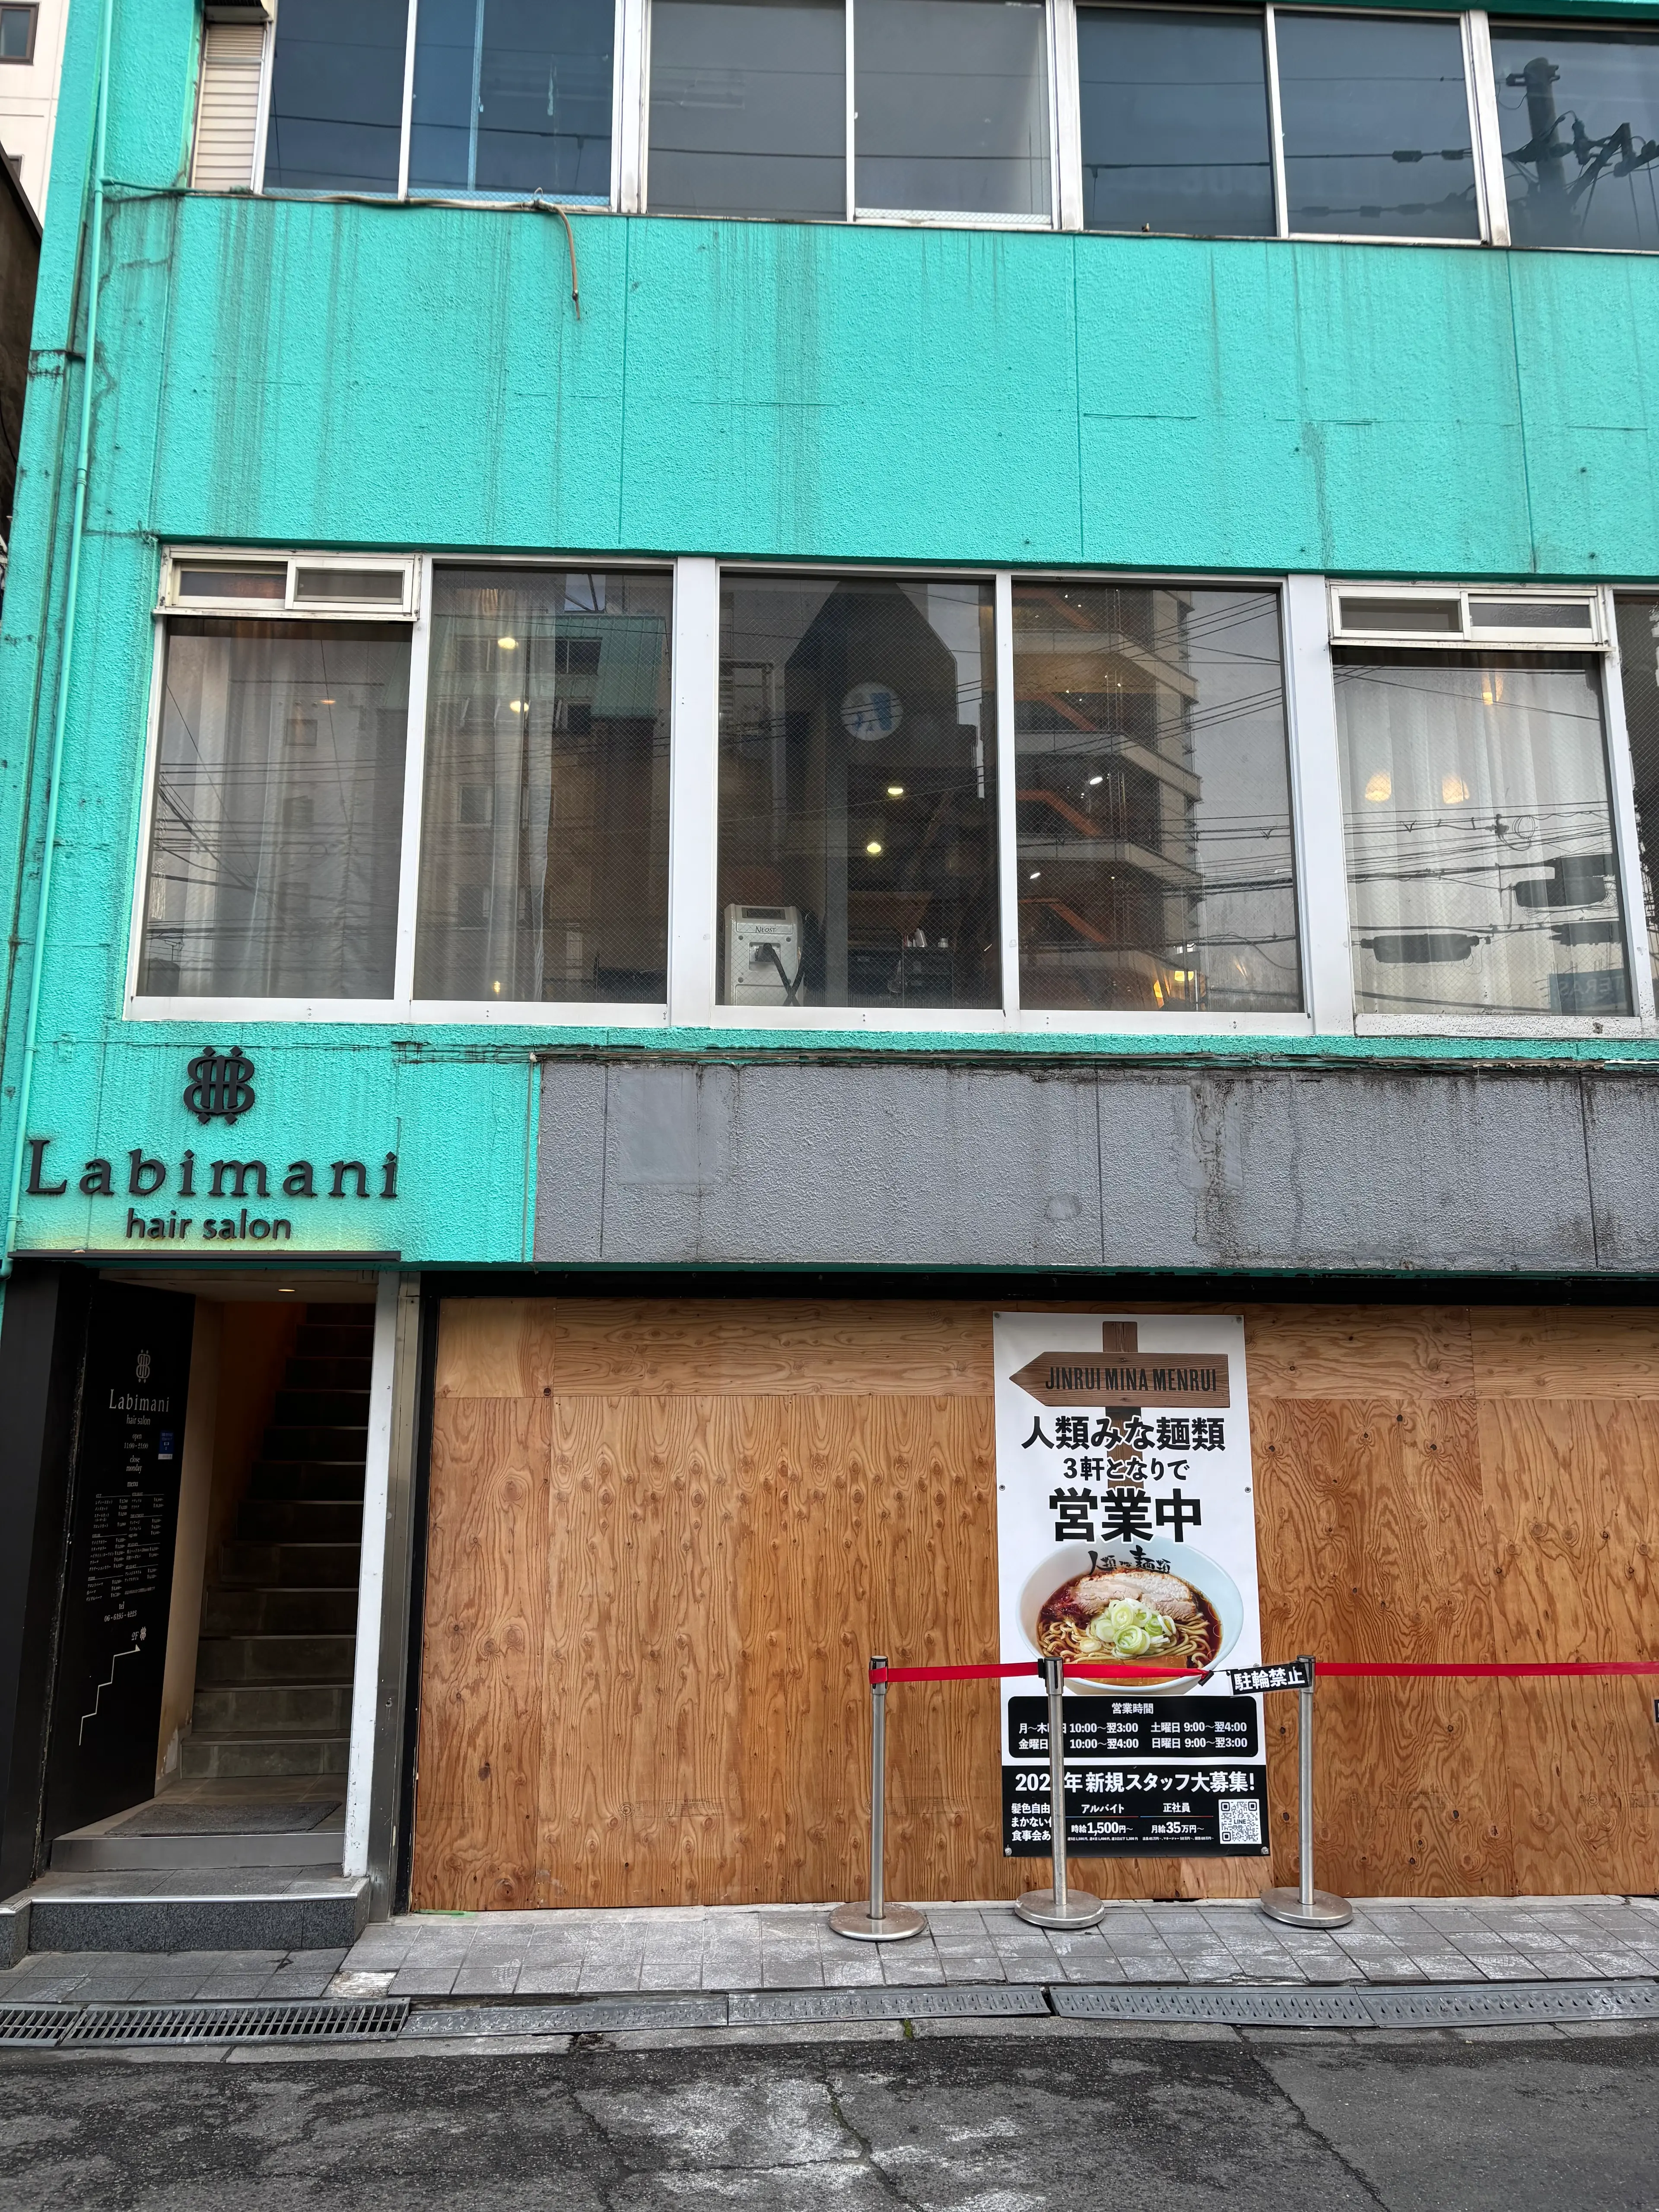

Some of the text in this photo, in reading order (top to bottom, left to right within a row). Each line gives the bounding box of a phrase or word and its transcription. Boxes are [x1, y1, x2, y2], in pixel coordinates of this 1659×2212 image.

[26, 1139, 397, 1197] Labimani
[127, 1208, 291, 1239] hair salon
[1046, 1367, 1216, 1392] JINRUI MINA MENRUI
[109, 1389, 169, 1412] Labimani
[126, 1415, 150, 1425] hair salon
[1021, 1416, 1225, 1451] 人類みな麺類
[126, 1463, 142, 1474] monday
[1063, 1456, 1190, 1481] 3軒となりで
[1049, 1487, 1202, 1543] 営業中
[1234, 1666, 1305, 1691] 駐輪禁止
[1112, 1703, 1154, 1714] 営業時間
[1069, 1722, 1138, 1734] 10:00〜翌3:00
[1150, 1722, 1180, 1733] 土曜日
[1184, 1721, 1247, 1732] 9:00〜翌4:00
[1018, 1737, 1248, 1750] 金曜日 10:00〜翌4:00 日曜日 9:00〜翌3:00
[1015, 1771, 1083, 1793] 202年
[1011, 1802, 1050, 1814] 髪色自由
[1081, 1804, 1125, 1814] アルバイト
[1163, 1802, 1191, 1813] 正社員
[1071, 1822, 1133, 1836] 時給1,500円〜
[1151, 1821, 1205, 1834] 月給35万円〜
